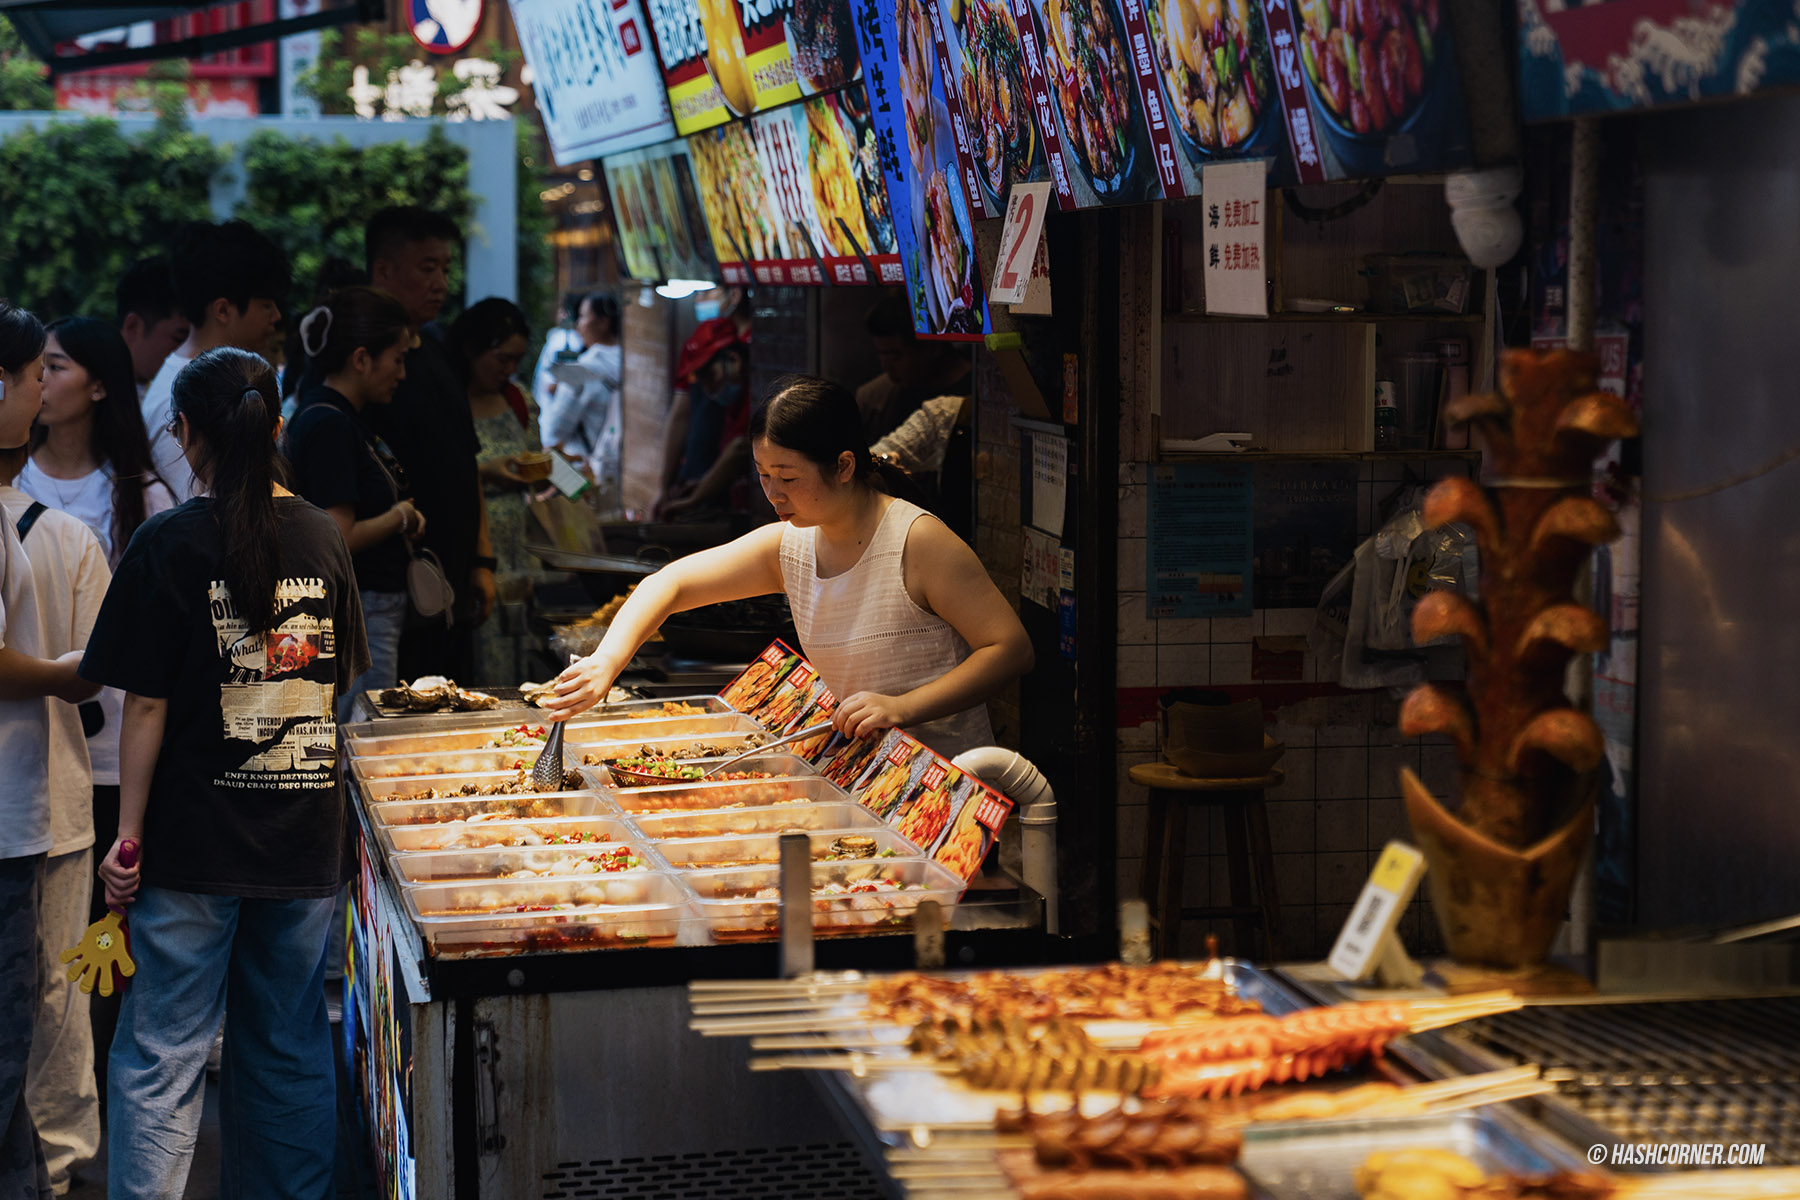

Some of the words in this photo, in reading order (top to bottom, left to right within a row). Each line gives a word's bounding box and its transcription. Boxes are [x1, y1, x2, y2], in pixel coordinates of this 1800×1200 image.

[1266, 0, 1318, 167] 花螺
[1224, 200, 1260, 228] 免费加工
[999, 193, 1034, 289] 2
[1224, 243, 1260, 271] 免费加热
[231, 639, 264, 658] What?
